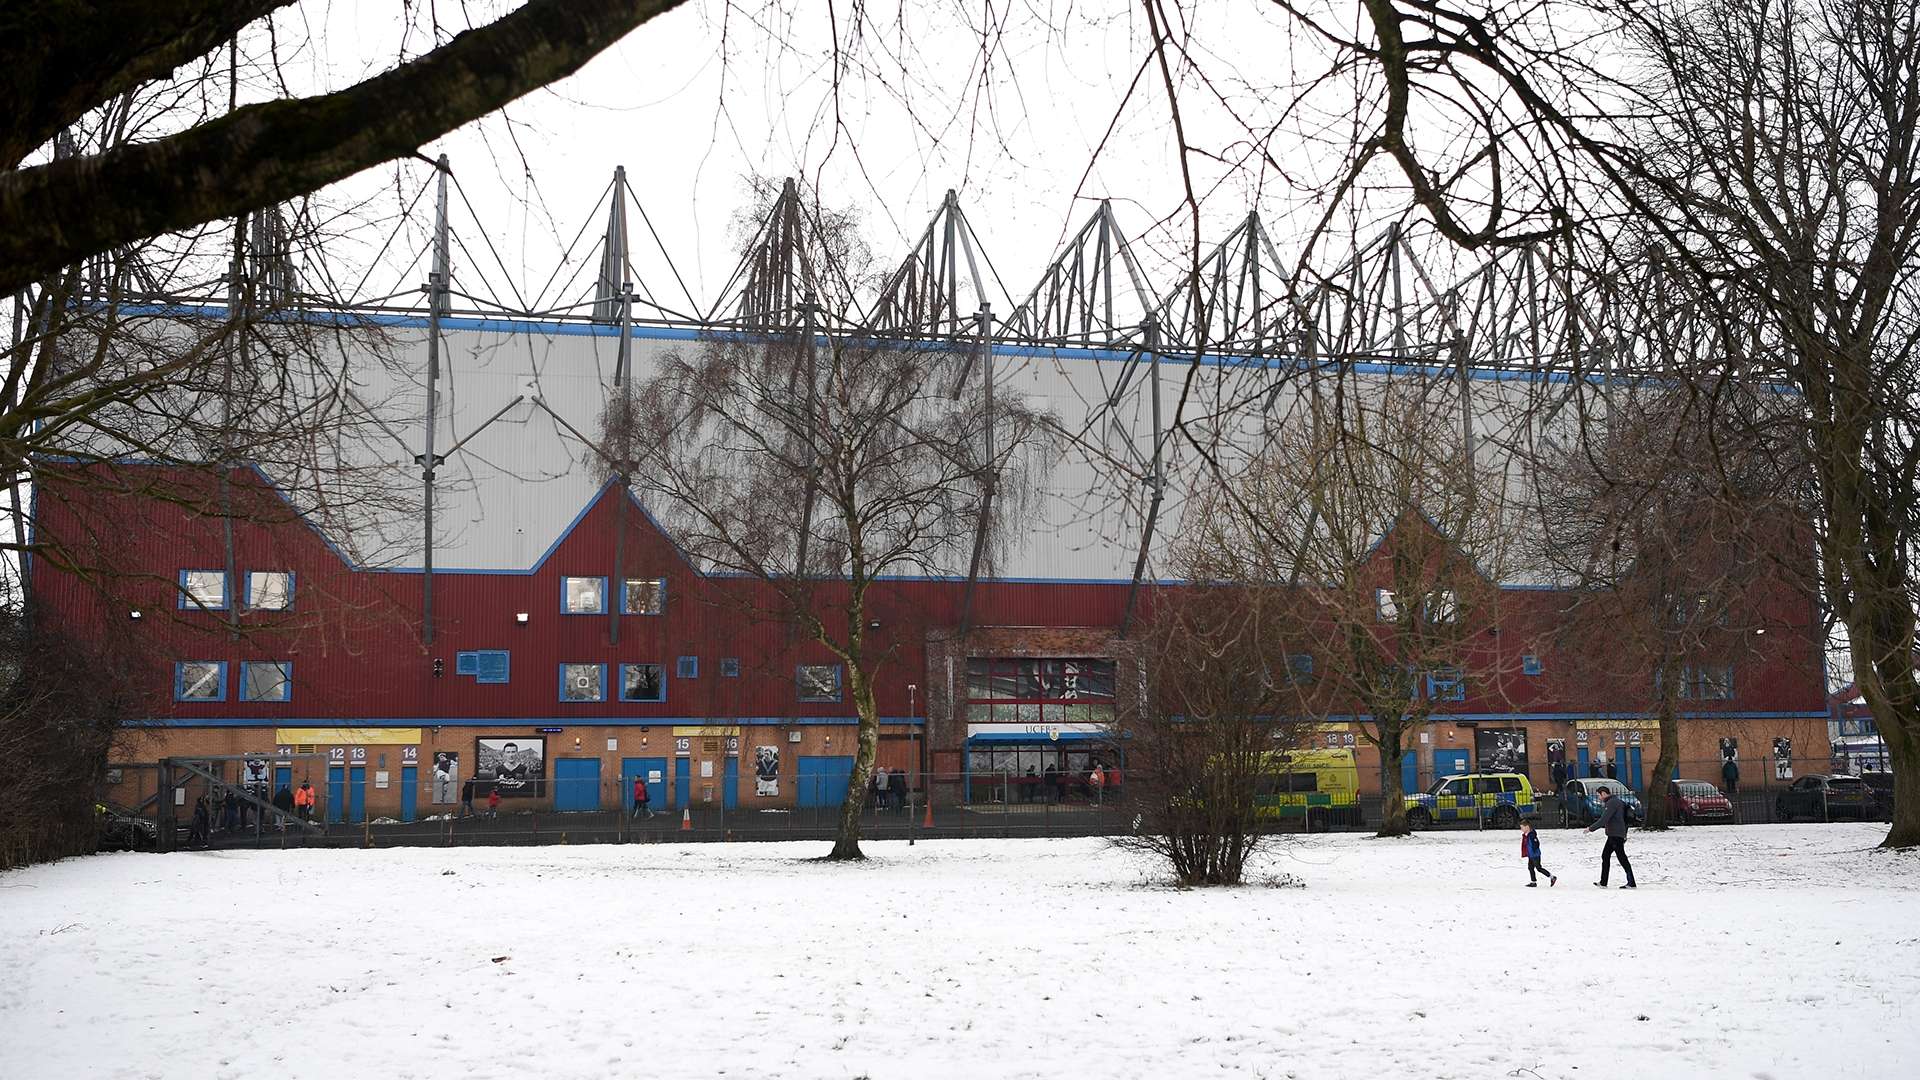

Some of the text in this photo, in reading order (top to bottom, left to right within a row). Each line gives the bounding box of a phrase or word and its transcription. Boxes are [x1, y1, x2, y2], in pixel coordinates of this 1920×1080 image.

[1327, 733, 1338, 743] 18
[1343, 733, 1354, 743] 19
[1577, 731, 1588, 741] 20
[1615, 731, 1625, 740] 21
[676, 738, 689, 749] 15
[330, 748, 344, 759] 12
[351, 748, 365, 758] 13
[402, 747, 417, 758] 14
